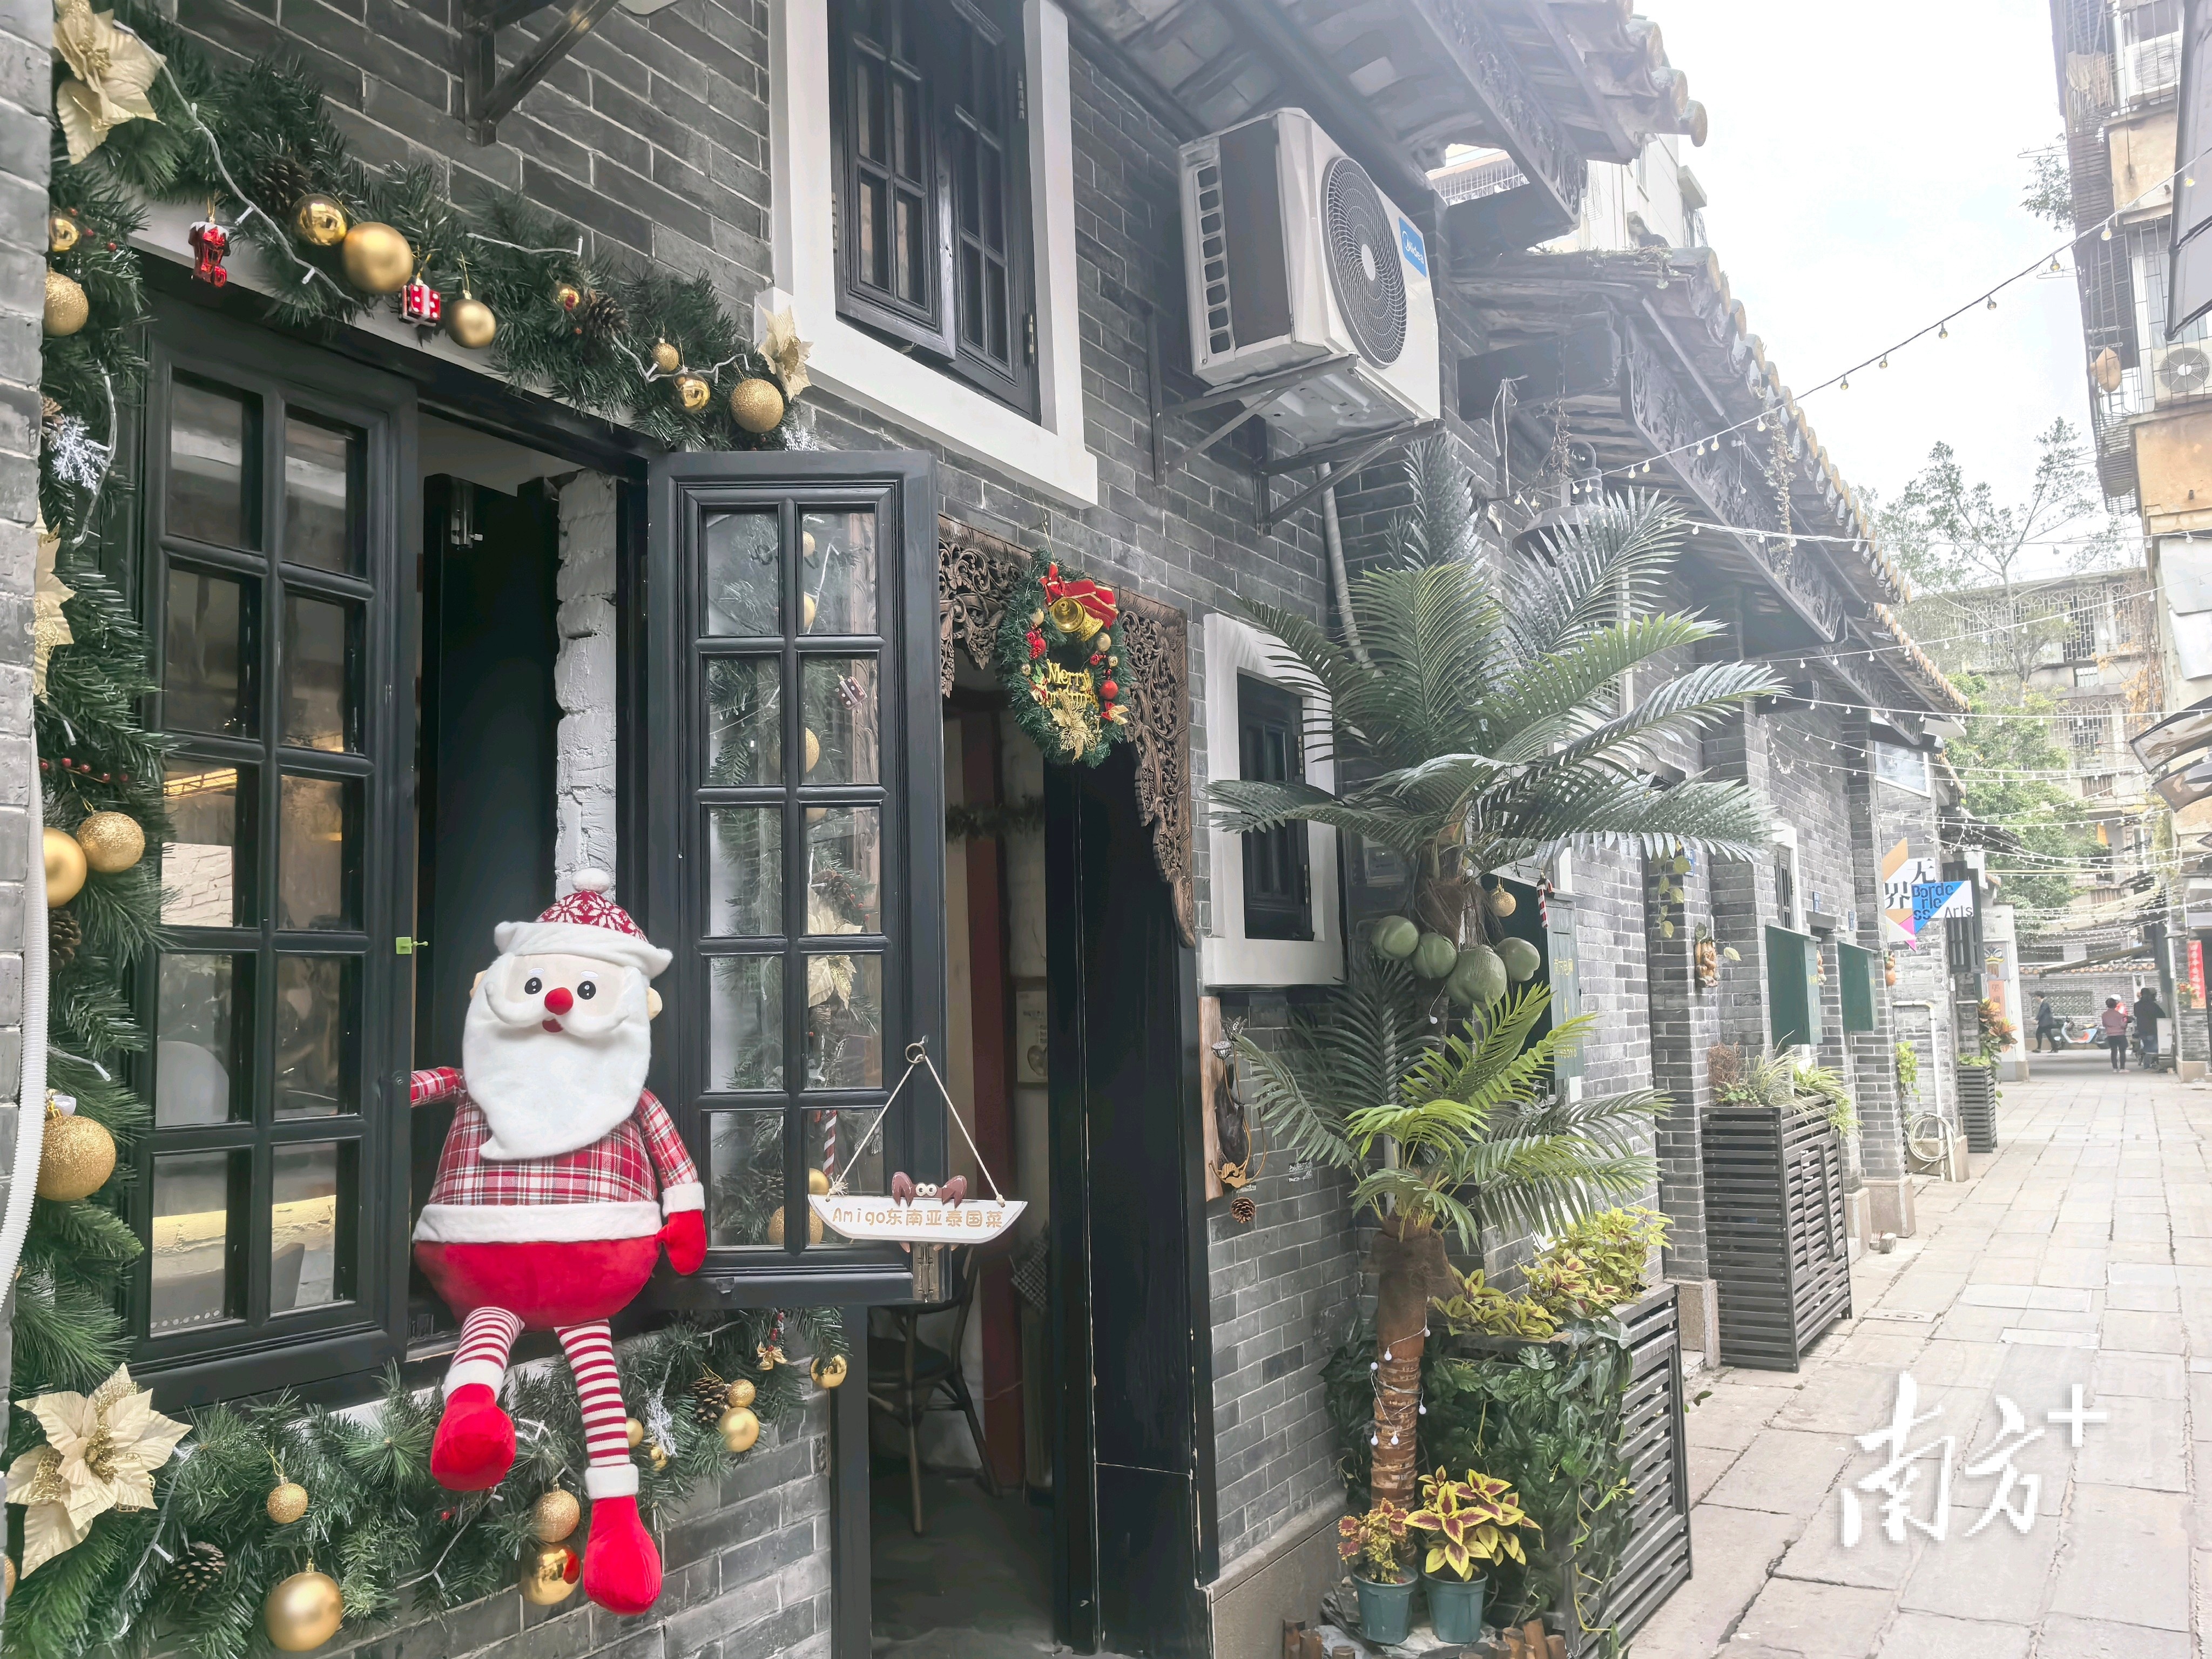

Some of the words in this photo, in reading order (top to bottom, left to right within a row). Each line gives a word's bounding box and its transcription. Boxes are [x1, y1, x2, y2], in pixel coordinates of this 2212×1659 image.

[1403, 232, 1424, 265] Midea
[1047, 658, 1091, 691] Merry
[832, 1207, 1003, 1229] Amigo东南亚泰国菜
